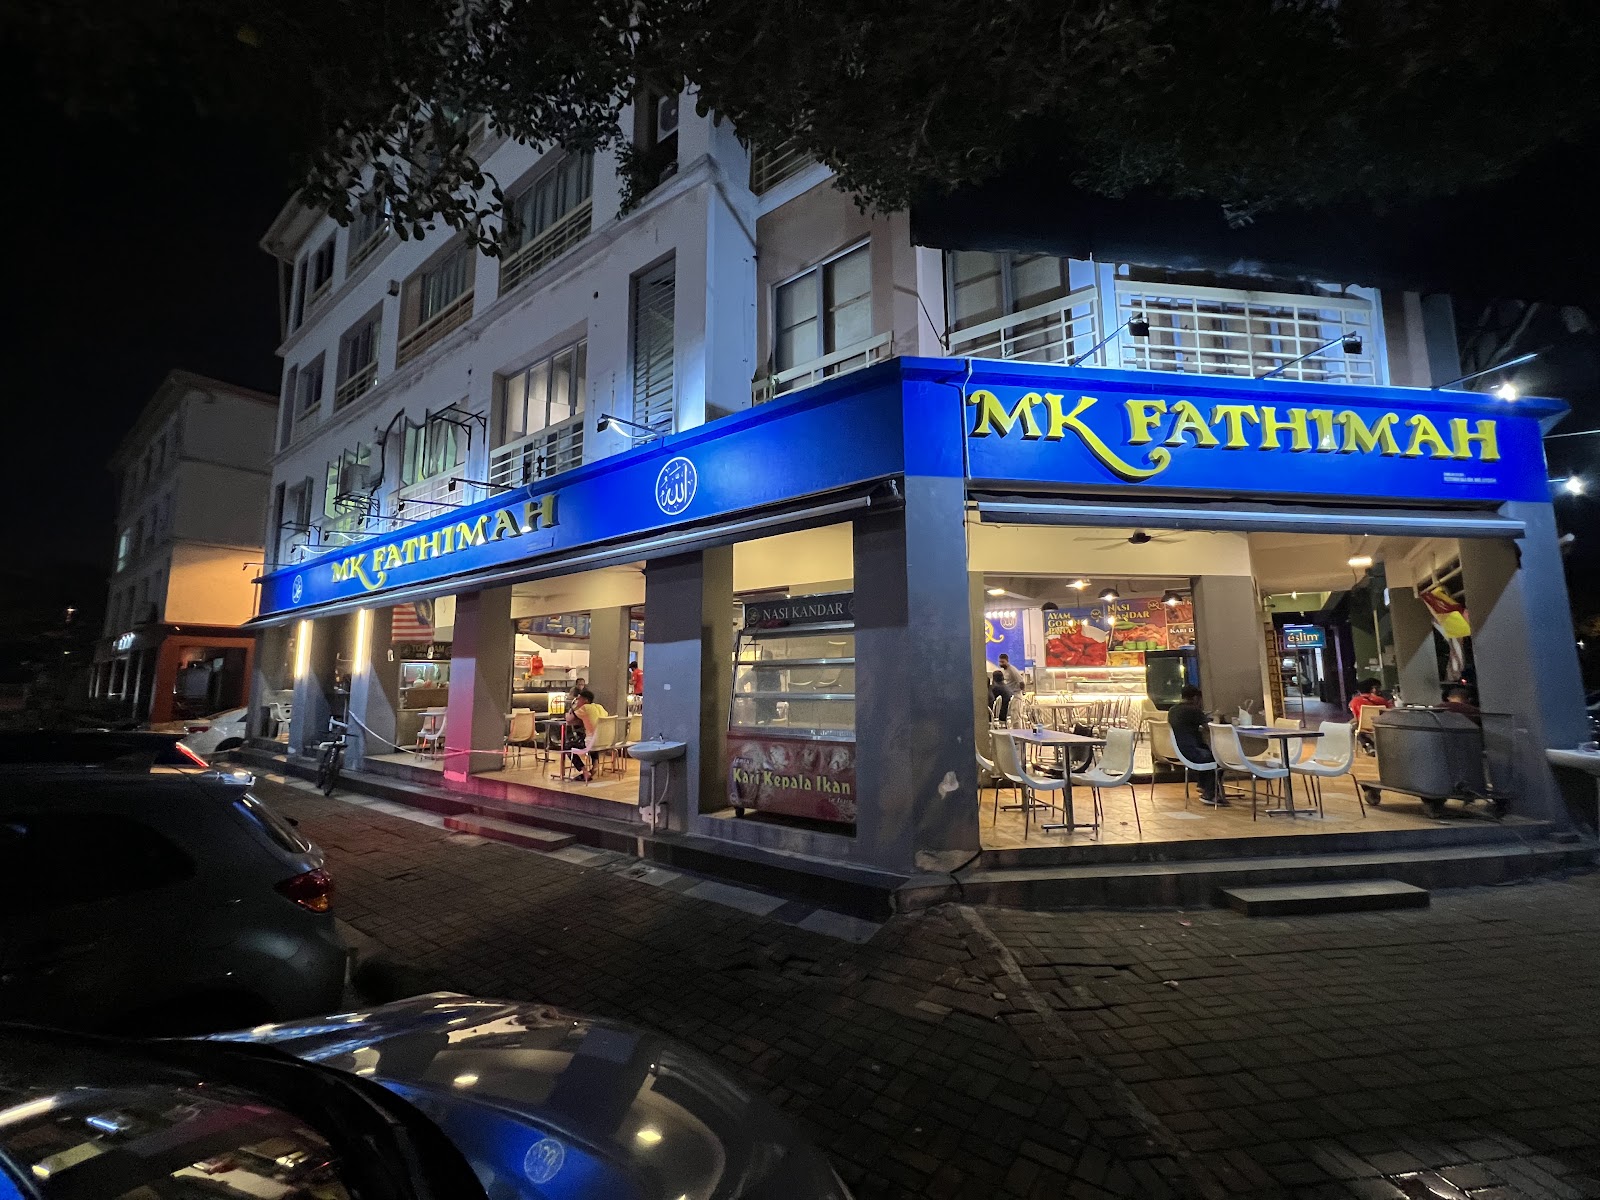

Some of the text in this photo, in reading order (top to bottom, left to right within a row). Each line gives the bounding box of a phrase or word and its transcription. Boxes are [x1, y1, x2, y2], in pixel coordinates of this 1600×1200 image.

[968, 390, 1501, 482] MK FATHIMAH
[331, 553, 387, 590] MK
[372, 493, 560, 573] FATHIMAH
[763, 602, 844, 621] NASI KANDAR
[1048, 612, 1071, 620] AYAM
[1107, 603, 1130, 612] NASI
[1107, 611, 1150, 621] ANDAR
[733, 768, 851, 795] Kari Kepala Ikan
